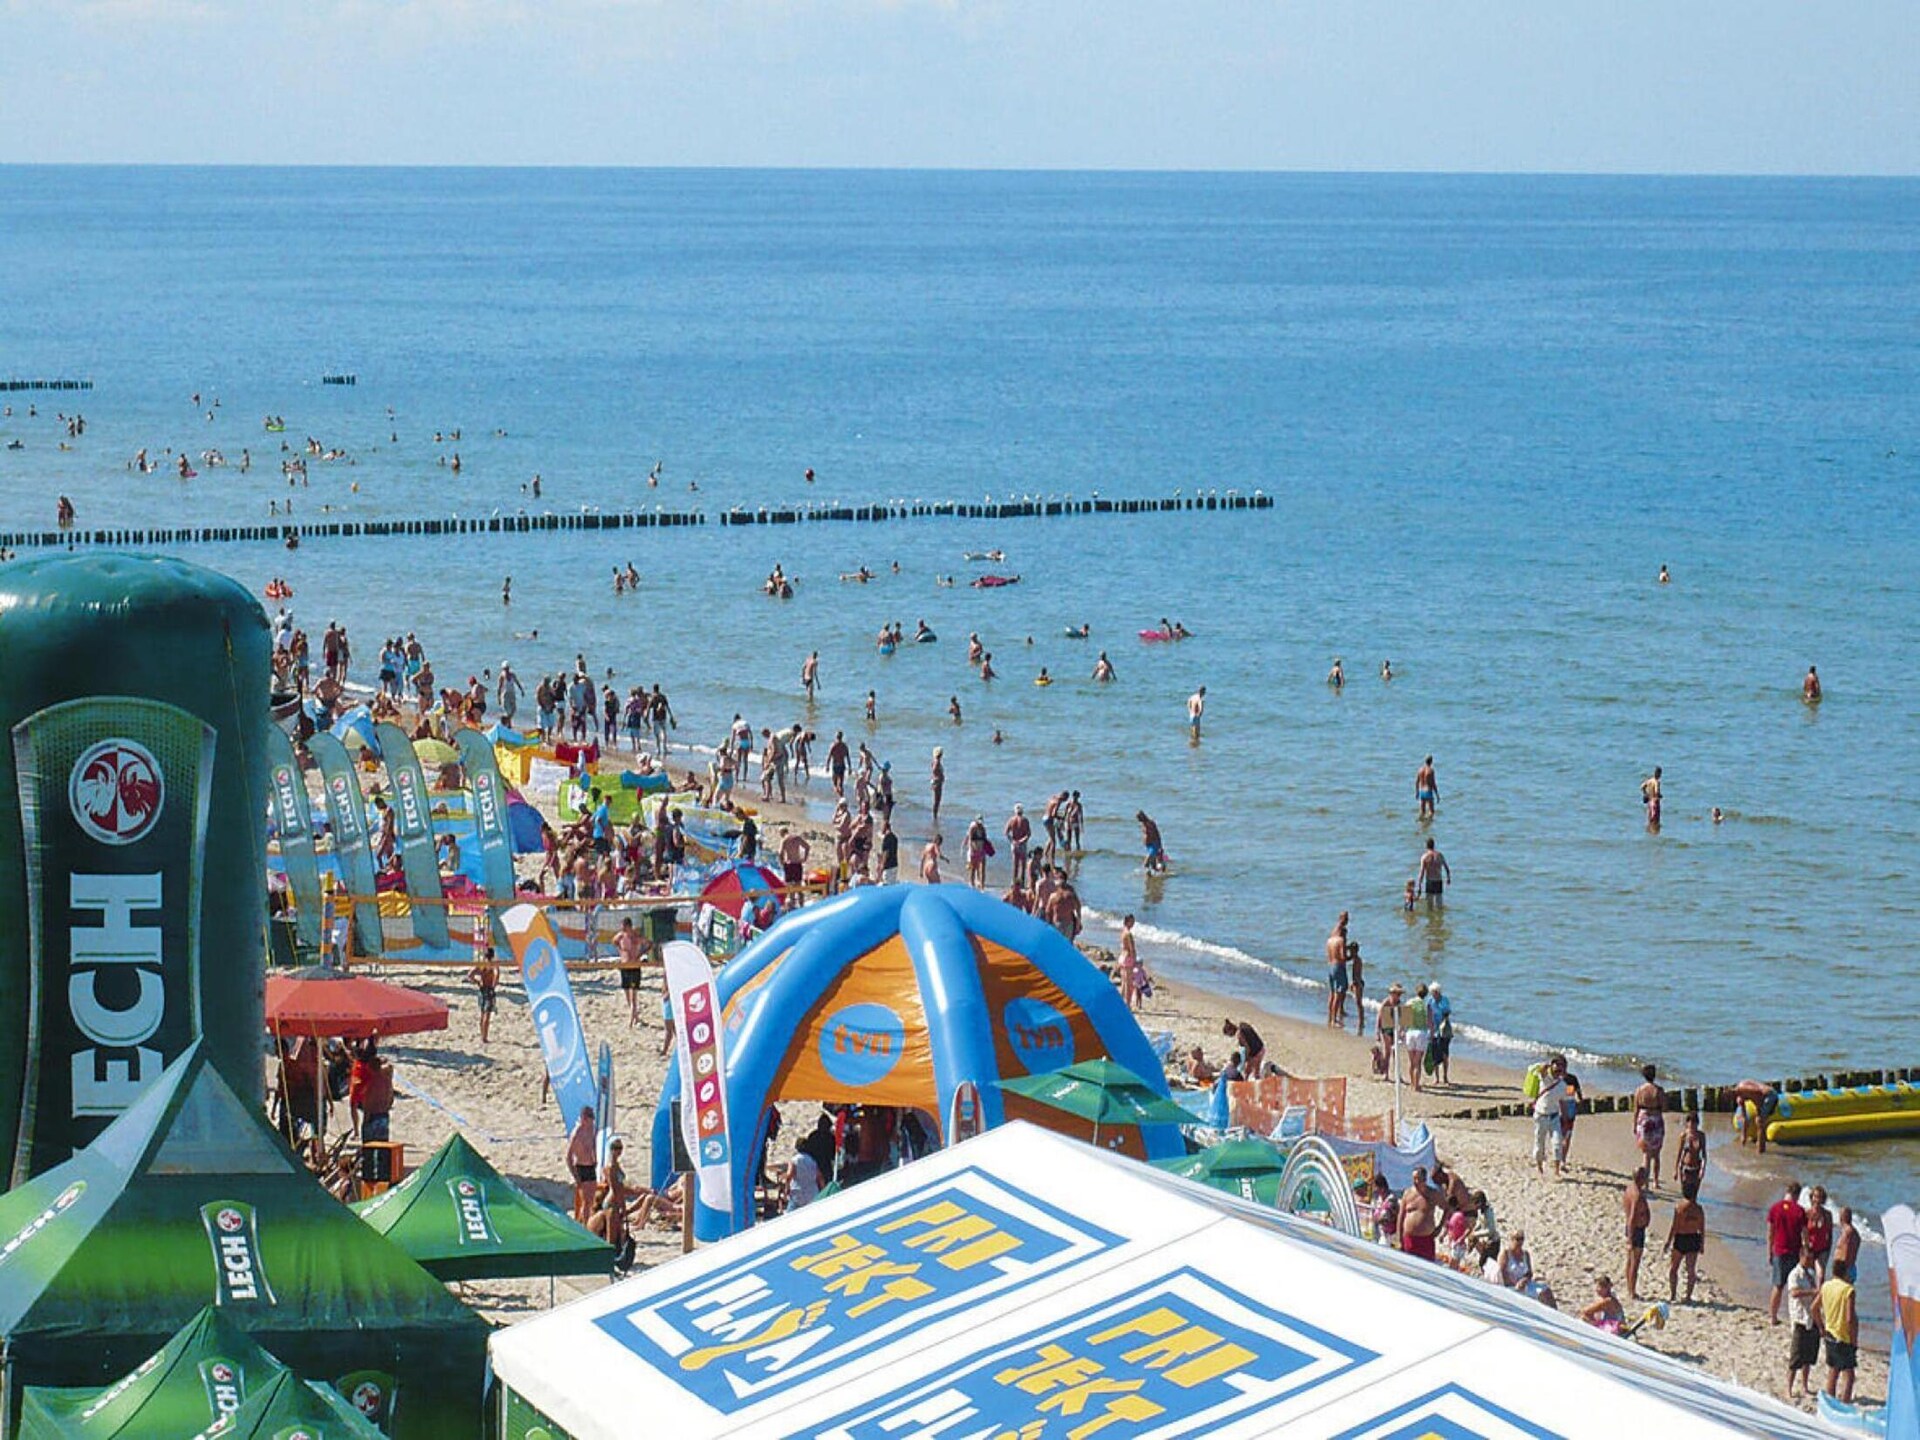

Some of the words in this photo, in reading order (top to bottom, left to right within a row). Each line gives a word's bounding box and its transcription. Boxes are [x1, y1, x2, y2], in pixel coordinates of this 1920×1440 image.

[68, 871, 165, 1162] ECH
[833, 1024, 893, 1057] tvn
[1015, 1022, 1064, 1051] tvn
[461, 1198, 489, 1240] LECH
[220, 1236, 258, 1298] LECH
[789, 1233, 937, 1320] JEKT
